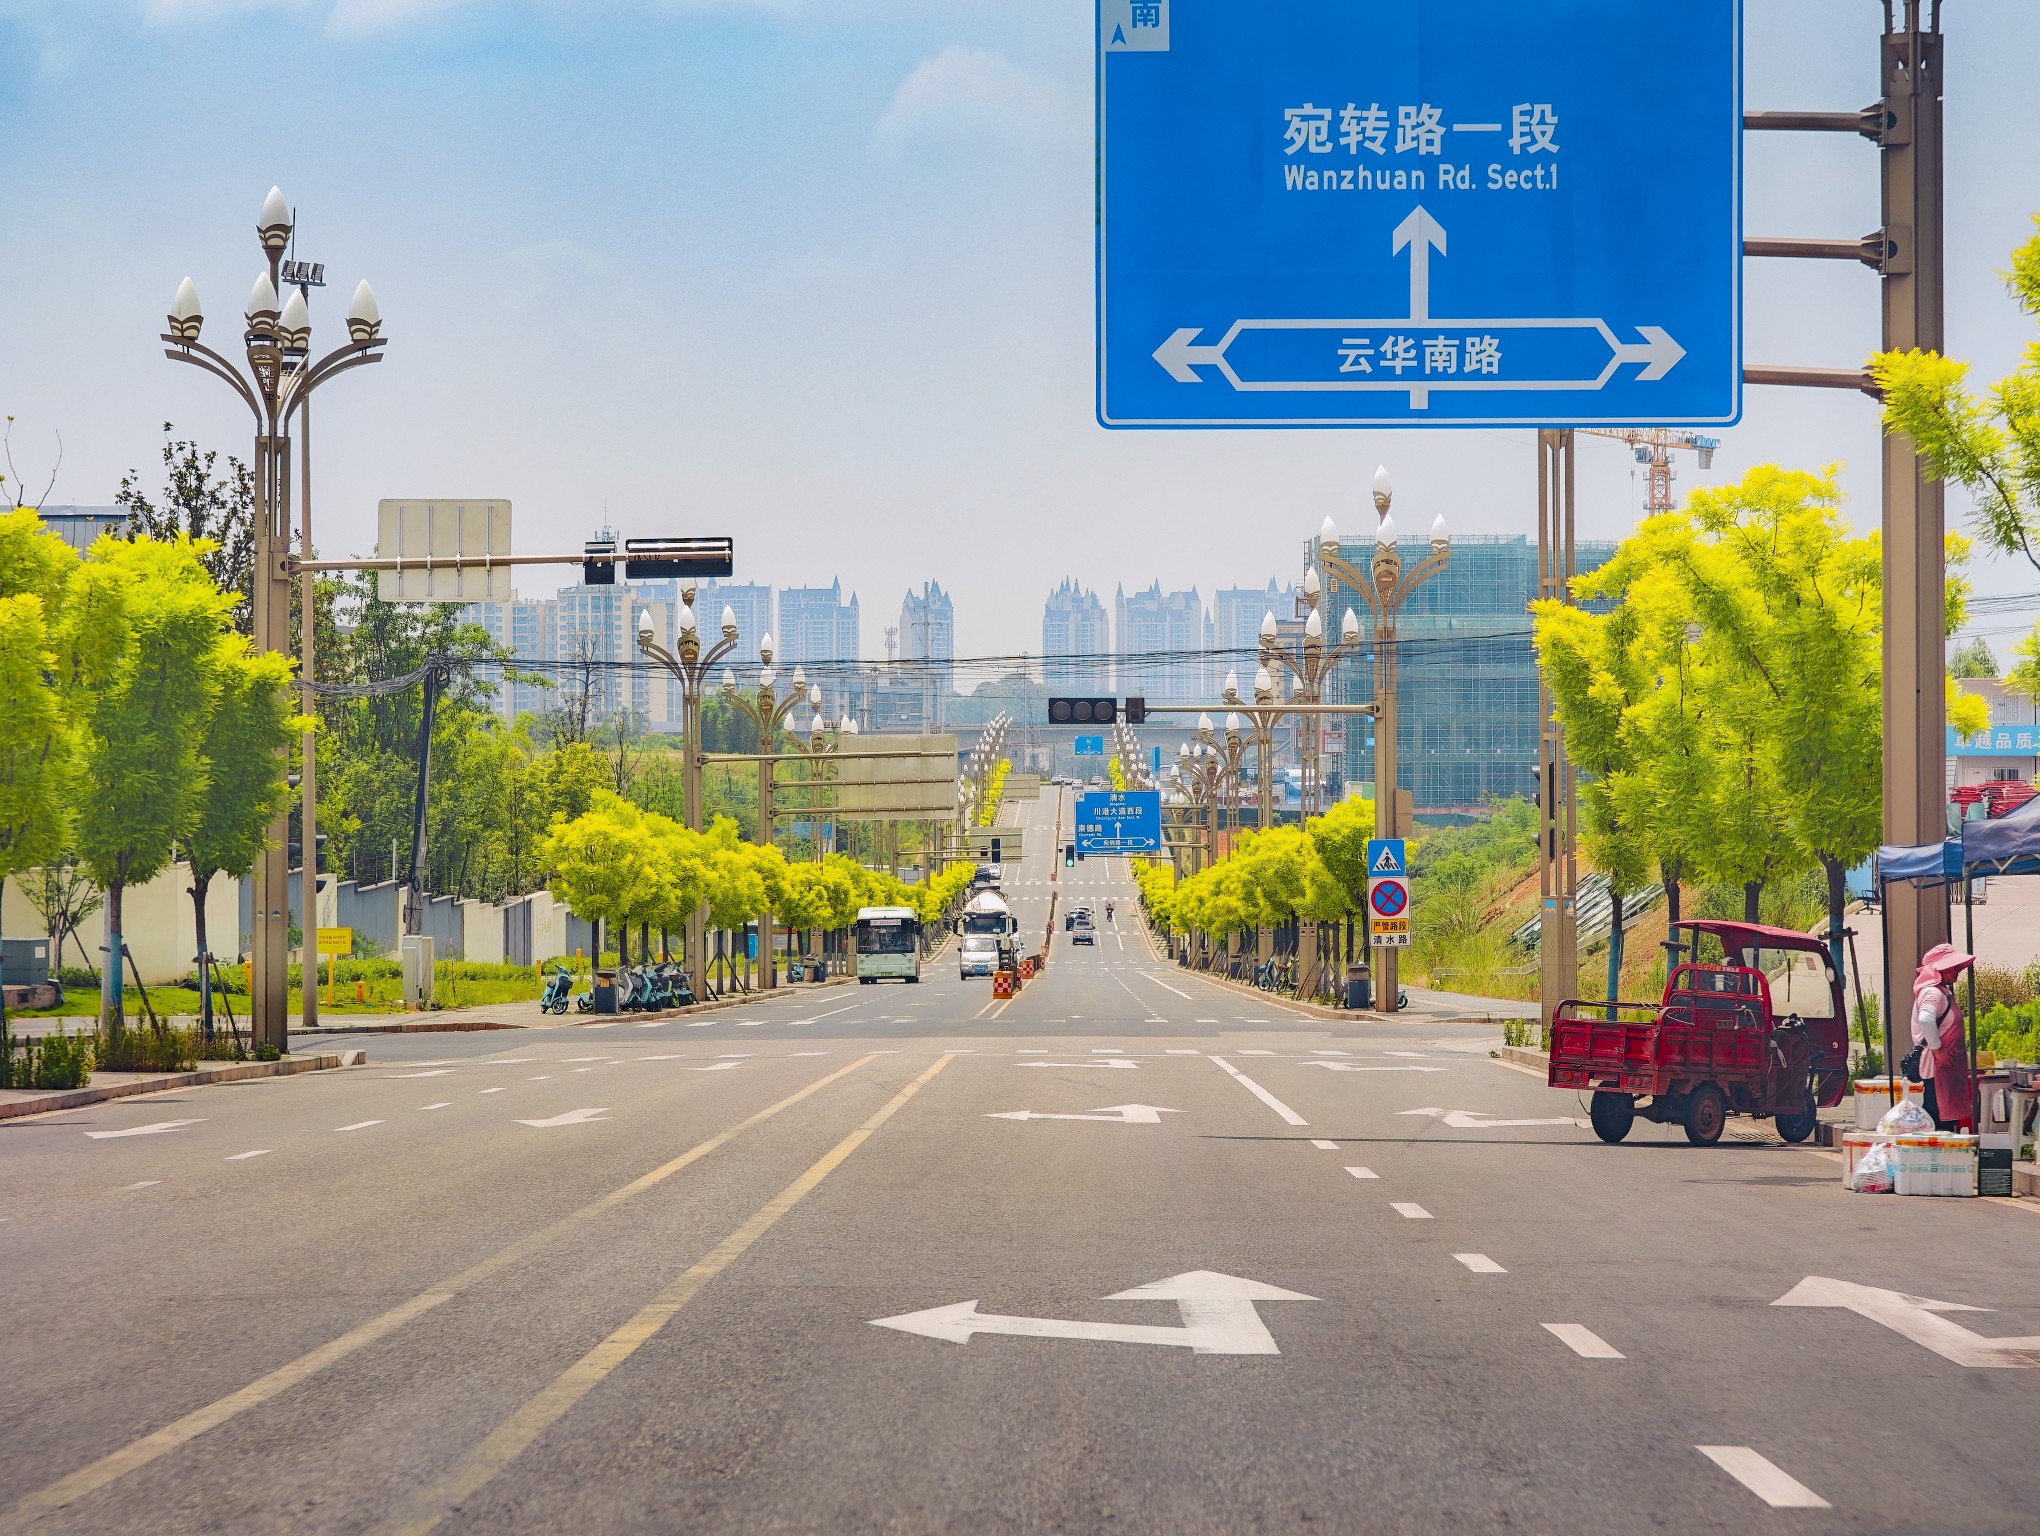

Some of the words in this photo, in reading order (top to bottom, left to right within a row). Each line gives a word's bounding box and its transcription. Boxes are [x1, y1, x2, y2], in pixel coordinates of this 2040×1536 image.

[1130, 0, 1161, 28] 南
[1284, 103, 1560, 156] 宛转路一段
[1284, 165, 1425, 191] Wanzhuan
[1439, 164, 1477, 190] Rd.
[1487, 164, 1558, 190] Sect.1
[1337, 335, 1503, 375] 云华南路
[1373, 921, 1407, 931] 严管路段
[1373, 935, 1407, 945] 清水路
